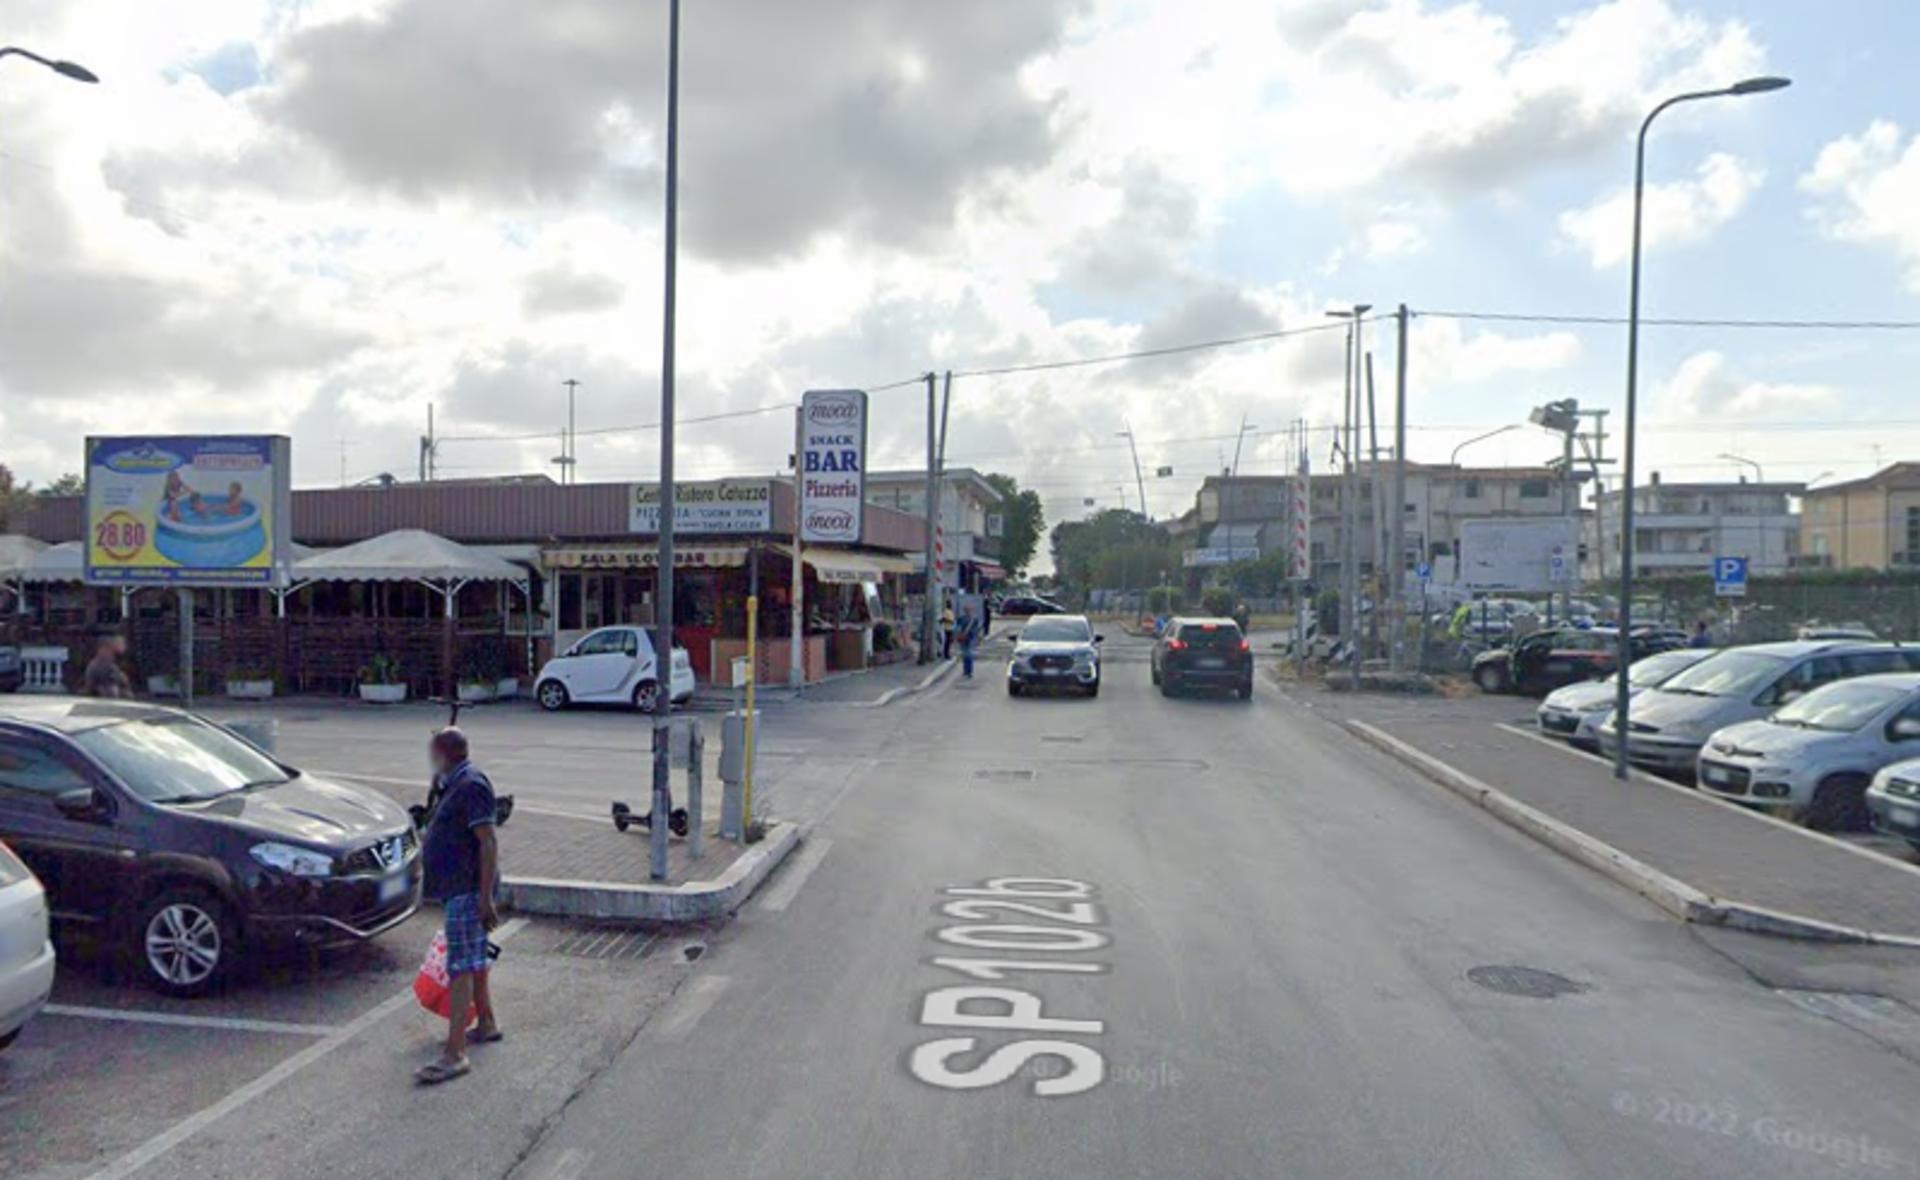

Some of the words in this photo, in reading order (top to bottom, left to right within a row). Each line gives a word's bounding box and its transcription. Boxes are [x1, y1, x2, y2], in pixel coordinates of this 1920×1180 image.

[809, 434, 854, 446] SNACK
[804, 450, 859, 472] BAR
[805, 478, 857, 499] Pizzeria
[636, 506, 690, 518] PIZZIA
[581, 553, 617, 564] SALA
[674, 552, 705, 563] BAR
[1721, 559, 1740, 580] P
